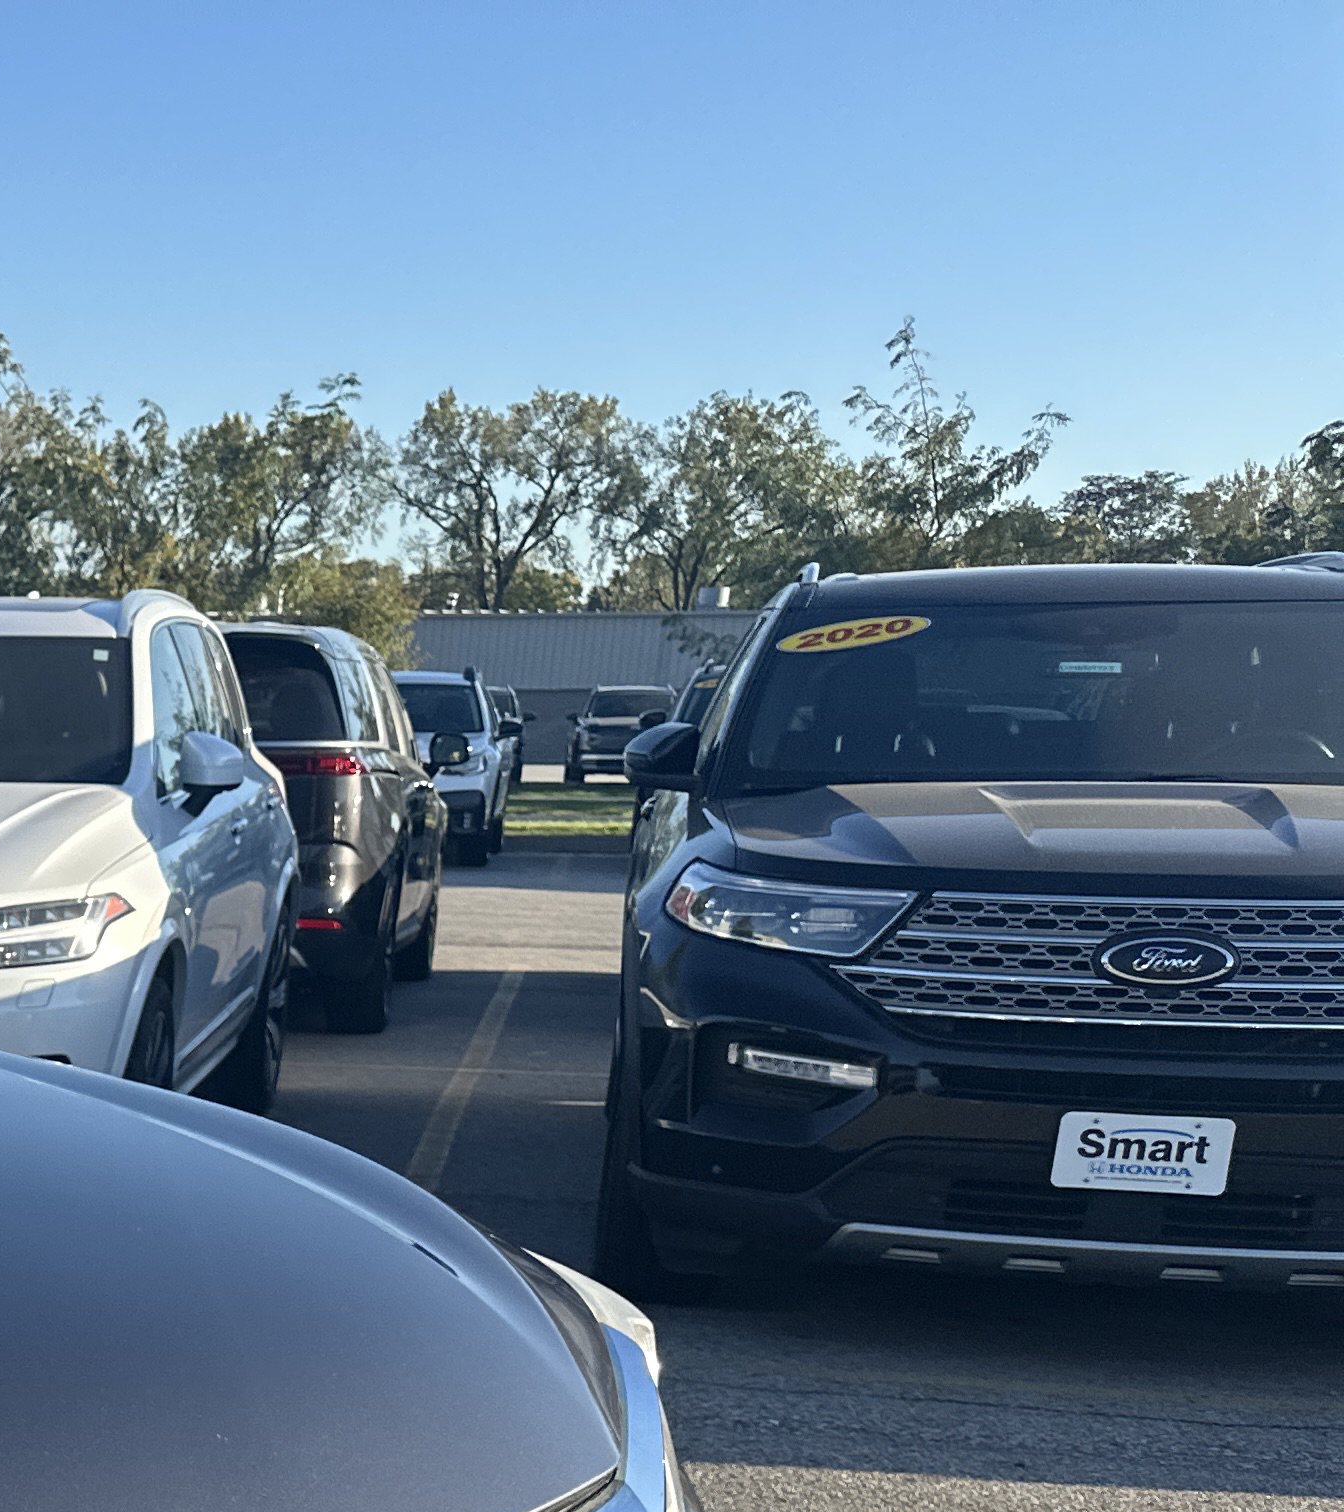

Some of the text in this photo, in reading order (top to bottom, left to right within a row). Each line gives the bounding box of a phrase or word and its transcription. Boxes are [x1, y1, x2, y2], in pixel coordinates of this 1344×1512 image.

[796, 618, 913, 649] 2020
[1132, 946, 1203, 973] Ford
[1077, 1128, 1210, 1164] Smart
[1108, 1163, 1193, 1177] HONDA
